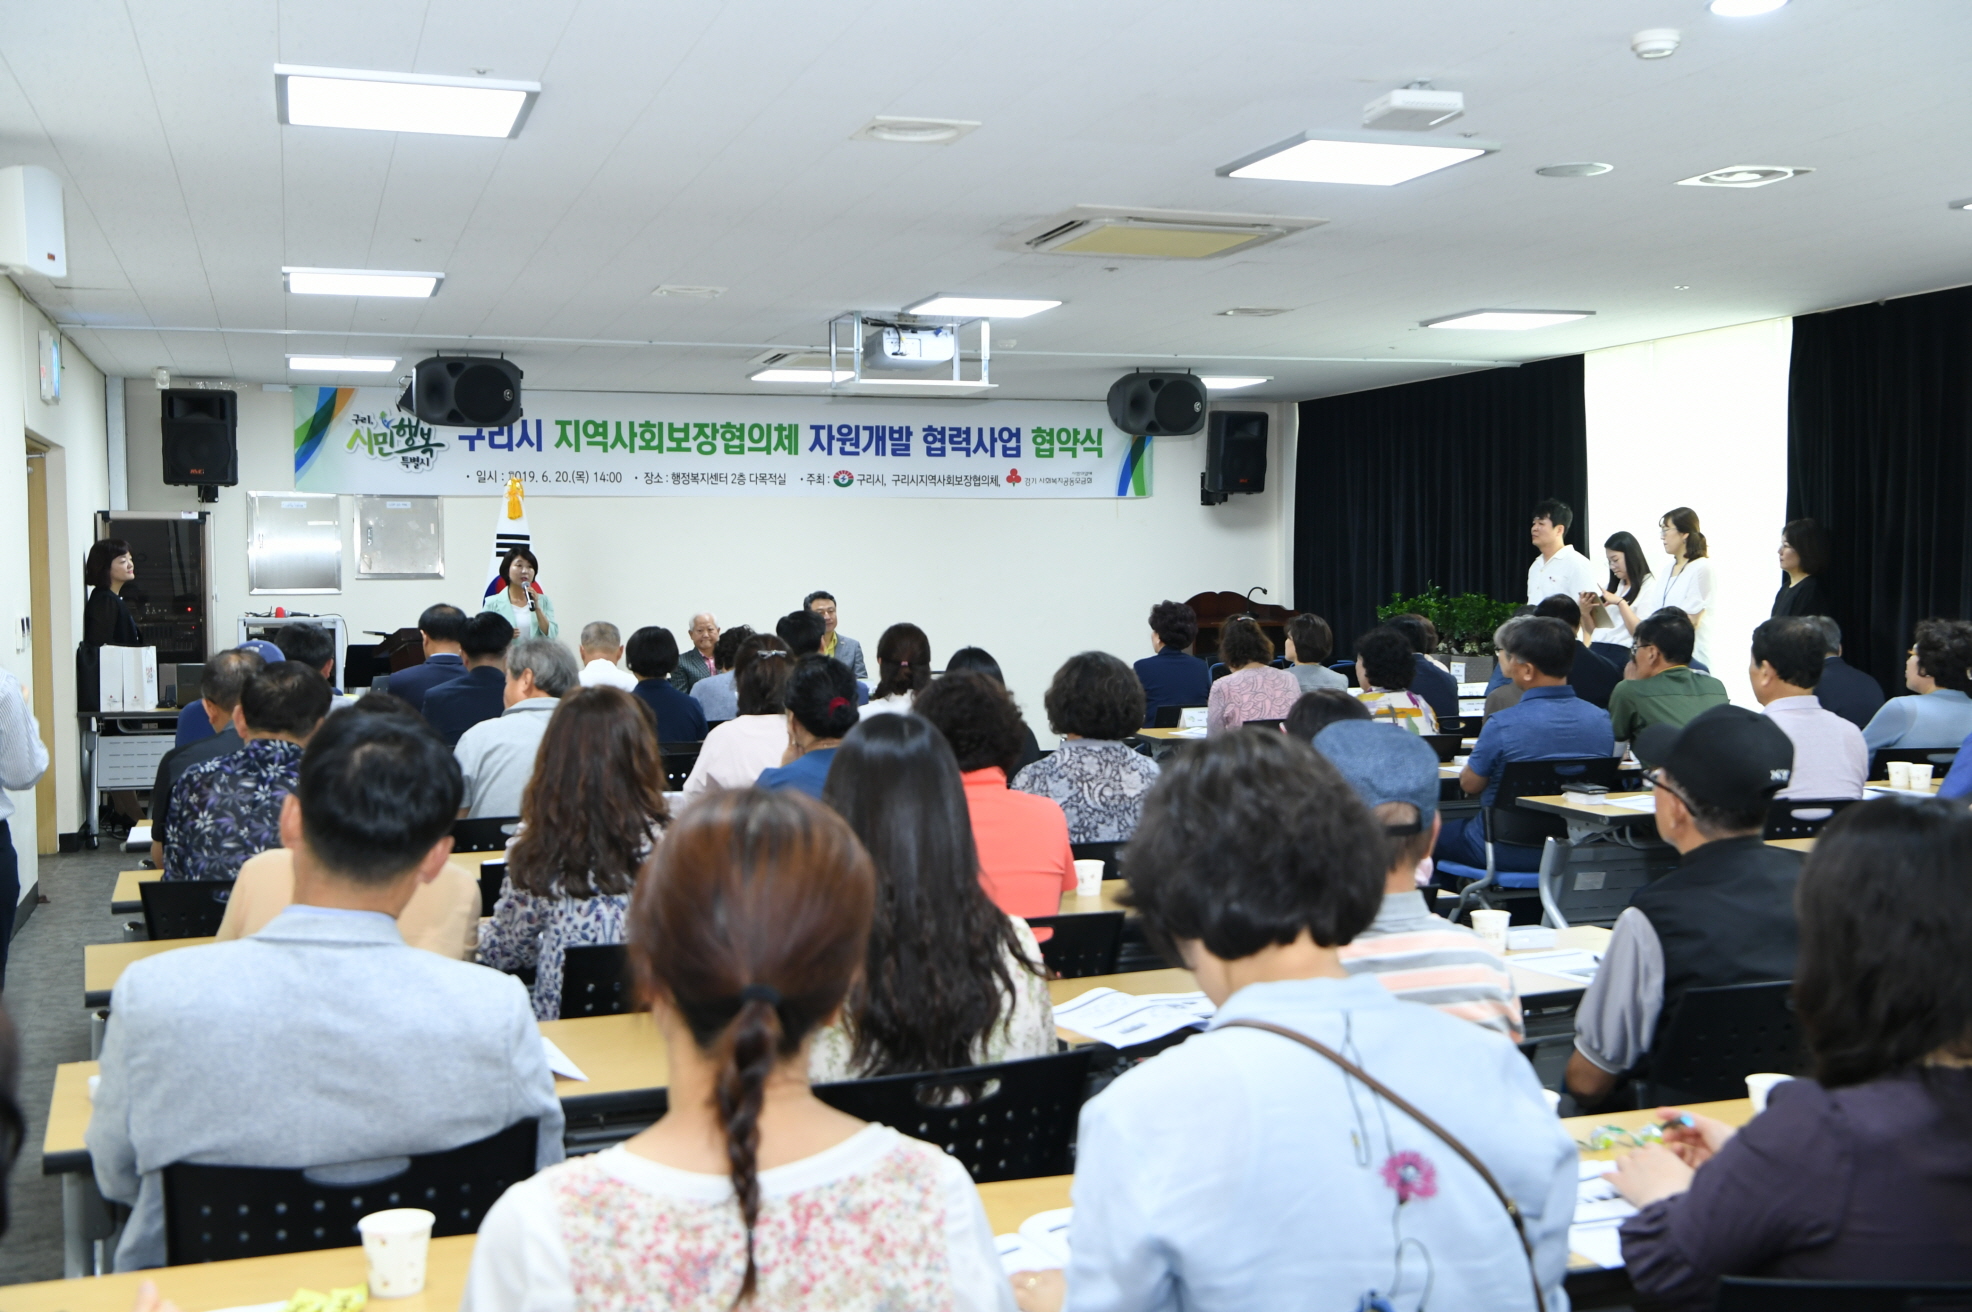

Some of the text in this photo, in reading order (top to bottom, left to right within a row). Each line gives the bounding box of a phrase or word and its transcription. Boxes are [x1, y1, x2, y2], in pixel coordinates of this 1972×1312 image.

[458, 418, 1103, 459] 구리시 지역사회보장협의체 자원개발 협력사업 협약식
[400, 455, 431, 470] 특별시
[594, 471, 623, 484] 14:00
[671, 471, 728, 486] 행정복지센터
[731, 472, 747, 486] 2층
[749, 472, 787, 486] 다목적실
[856, 473, 887, 487] 구리시,
[891, 473, 1001, 488] 구리시지역사회보장협의체,
